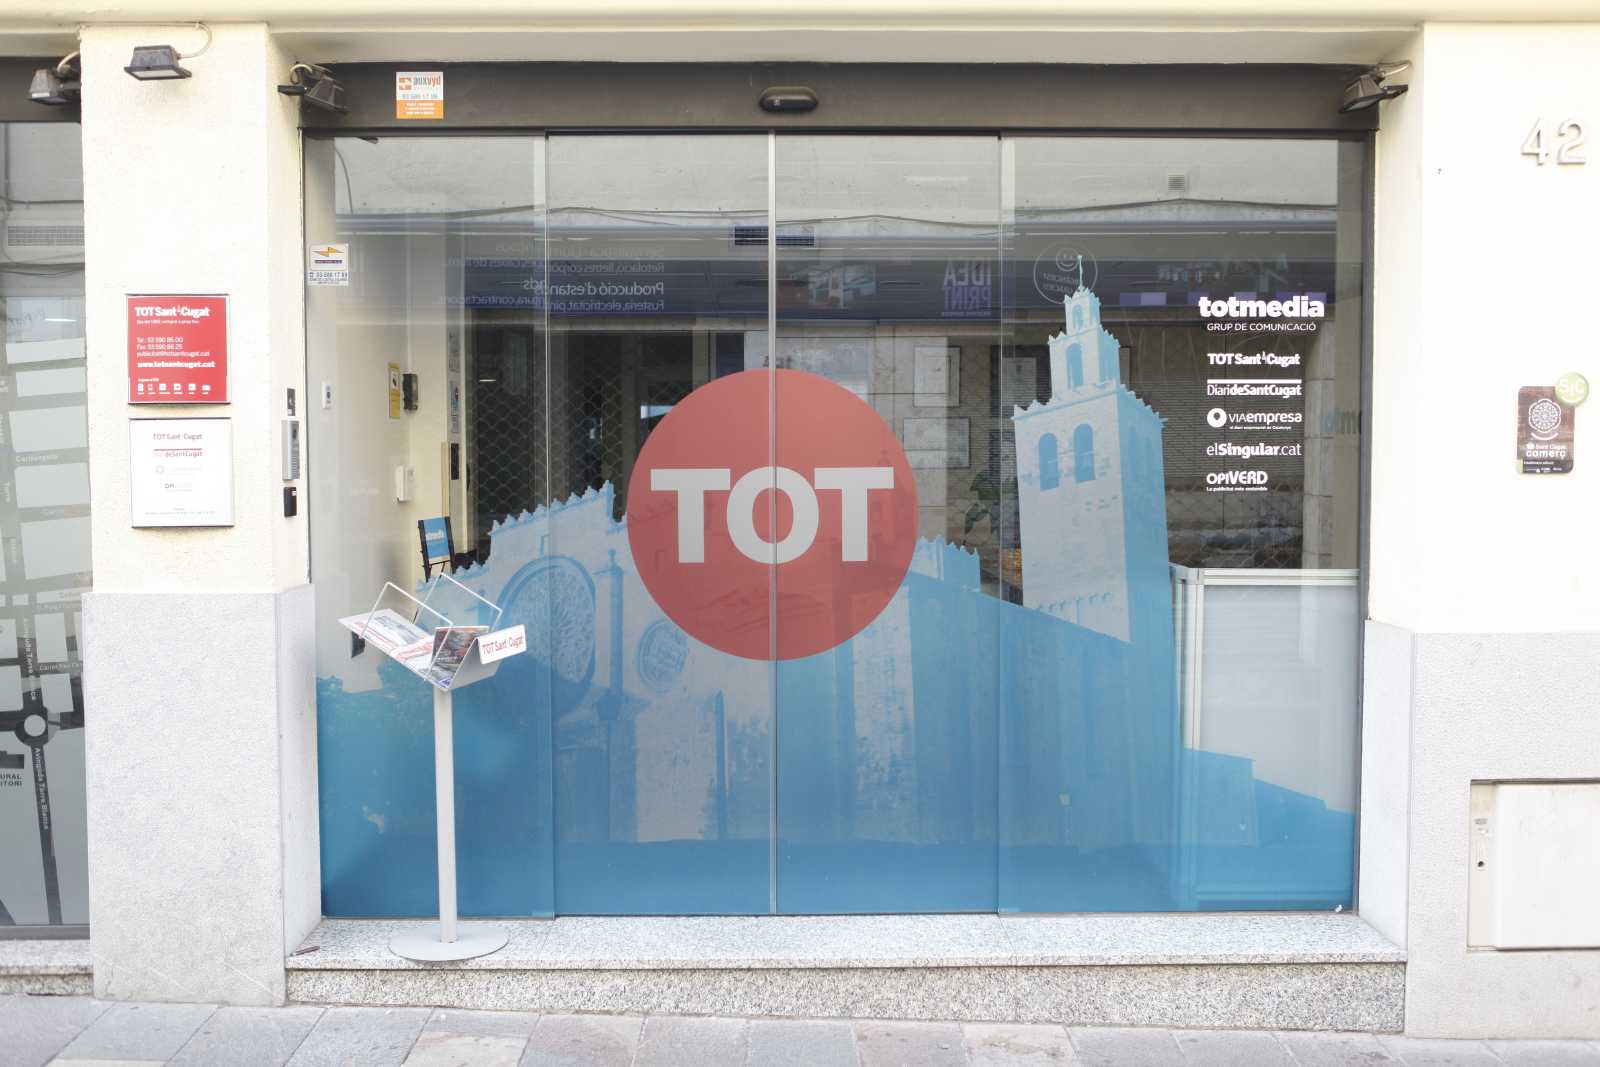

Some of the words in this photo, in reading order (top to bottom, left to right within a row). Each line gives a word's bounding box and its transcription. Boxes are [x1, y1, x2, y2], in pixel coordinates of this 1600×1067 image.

[1520, 117, 1586, 167] 42
[135, 306, 154, 317] TOT
[155, 306, 177, 317] Sant
[180, 306, 210, 318] Cugat
[1199, 296, 1325, 317] totmedia
[1206, 323, 1233, 331] GRUP
[1234, 323, 1248, 331] DE
[1249, 321, 1317, 331] COMUNICACIÓ
[1207, 353, 1235, 365] TOT
[1235, 353, 1261, 365] Sant
[1266, 353, 1301, 367] Cugat
[1207, 384, 1302, 398] DiarideSantCugat
[1229, 412, 1303, 425] VIAempresa
[1206, 442, 1303, 459] elSingular.cat
[1525, 449, 1566, 459] comerç
[650, 466, 895, 564] TOT
